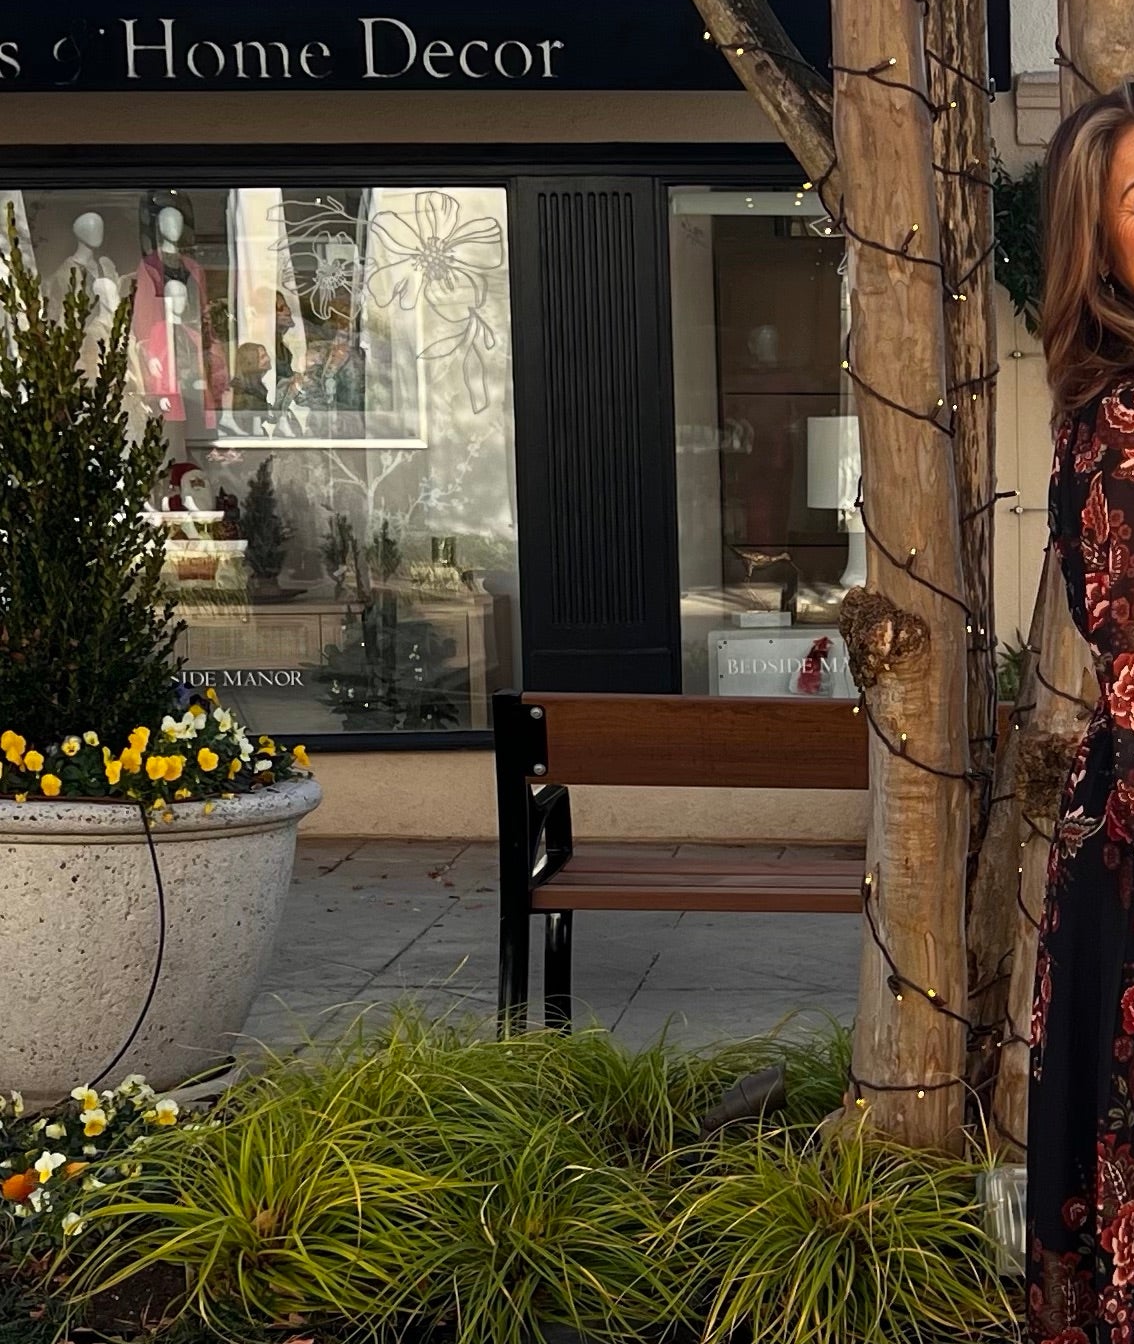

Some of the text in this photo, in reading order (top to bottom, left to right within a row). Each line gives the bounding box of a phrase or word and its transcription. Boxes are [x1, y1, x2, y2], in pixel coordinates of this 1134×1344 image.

[118, 17, 333, 78] Home
[357, 17, 565, 78] Decor
[727, 657, 814, 674] BEDSIDE
[223, 670, 305, 687] MANOR
